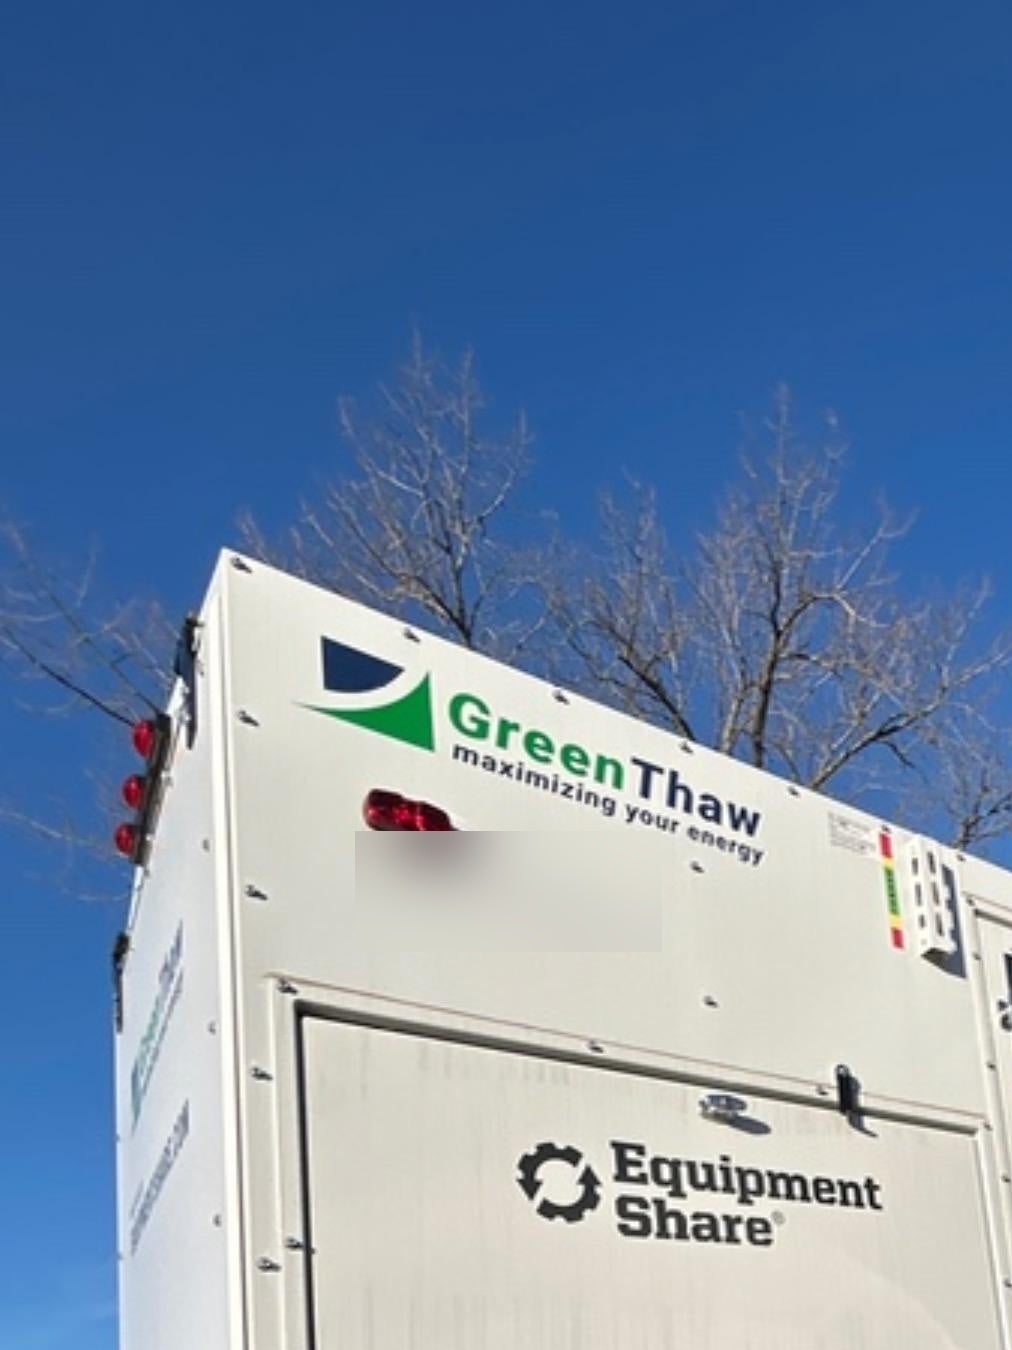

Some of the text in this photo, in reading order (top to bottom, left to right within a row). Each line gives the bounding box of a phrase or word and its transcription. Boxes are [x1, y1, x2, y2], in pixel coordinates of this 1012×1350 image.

[448, 692, 762, 837] GreenThaw
[452, 742, 765, 867] maximizing your energy
[610, 1140, 883, 1210] Equipment
[615, 1195, 773, 1246] Share
